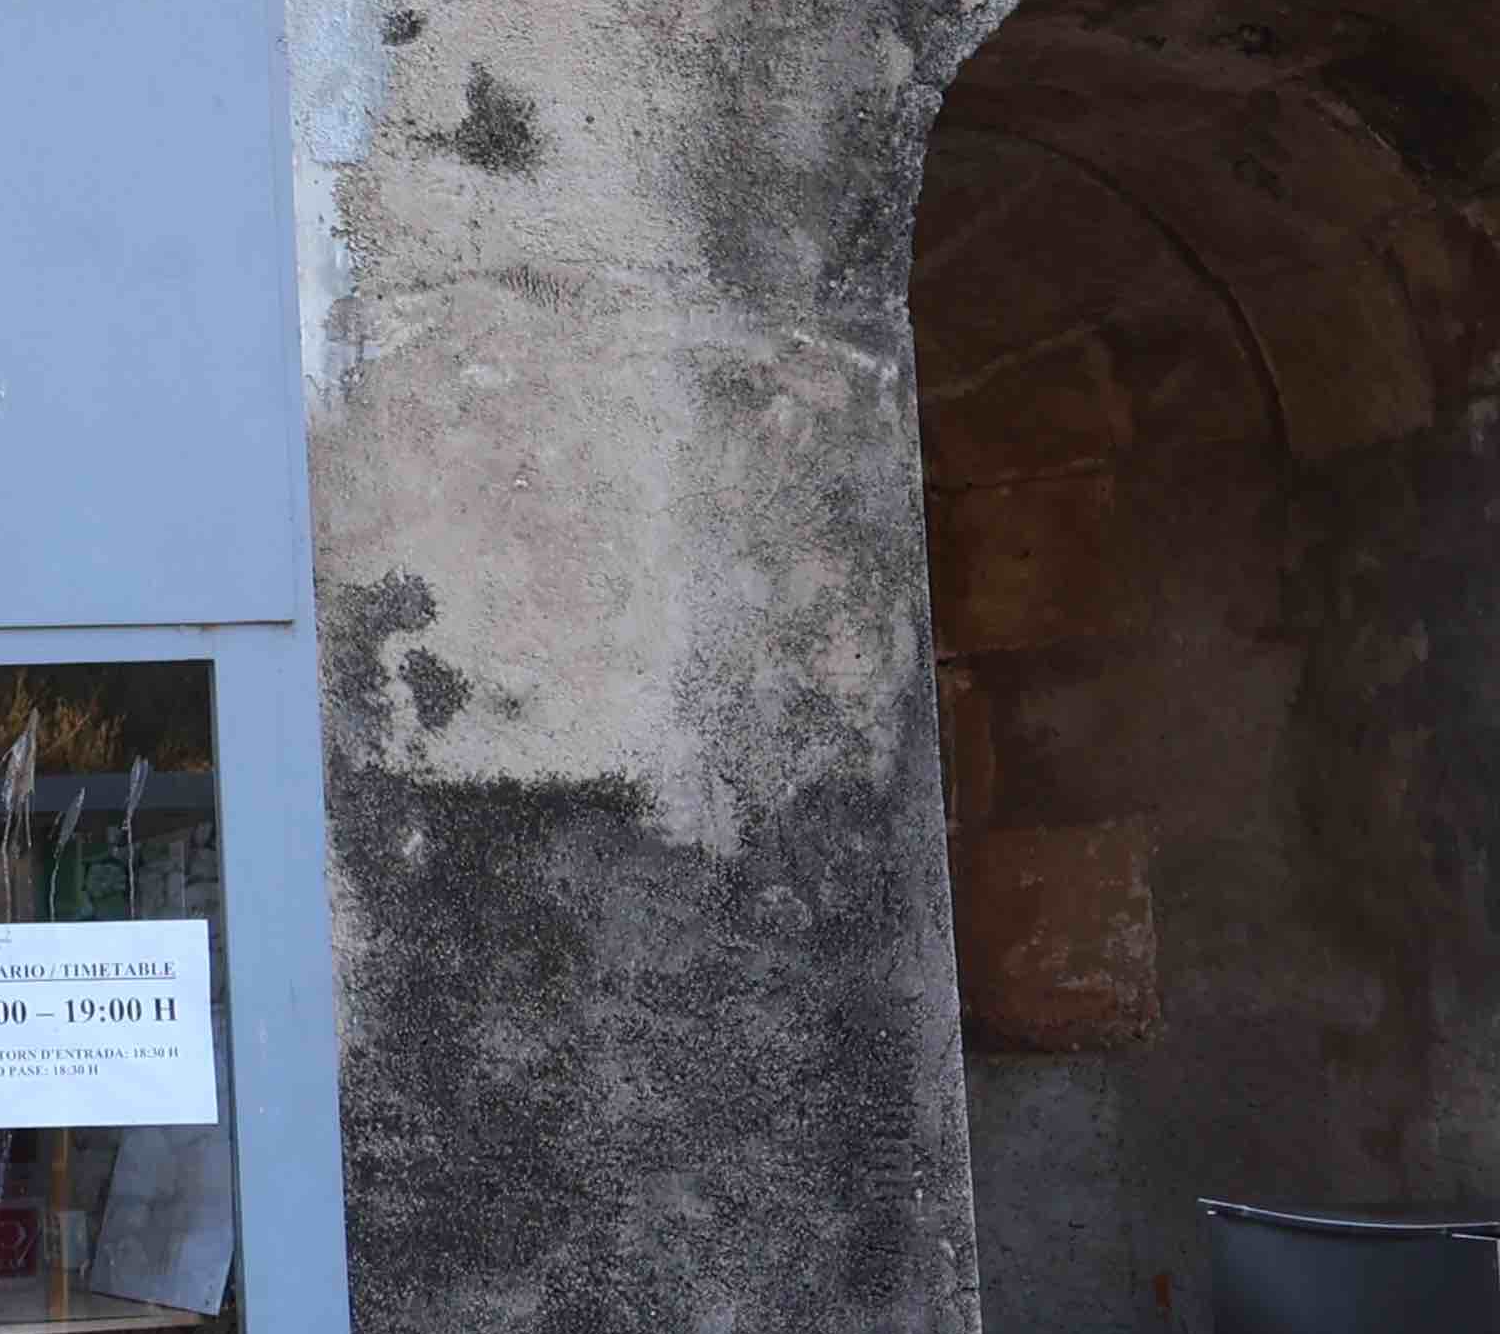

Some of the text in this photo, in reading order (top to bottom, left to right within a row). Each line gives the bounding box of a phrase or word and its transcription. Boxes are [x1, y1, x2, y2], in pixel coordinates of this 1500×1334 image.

[61, 962, 176, 978] TIMETABLE
[65, 997, 142, 1024] 19:00
[154, 997, 178, 1022] H
[133, 1047, 166, 1059] 18:30
[169, 1047, 179, 1058] H
[53, 1064, 85, 1077] 18:30
[88, 1064, 98, 1076] H
